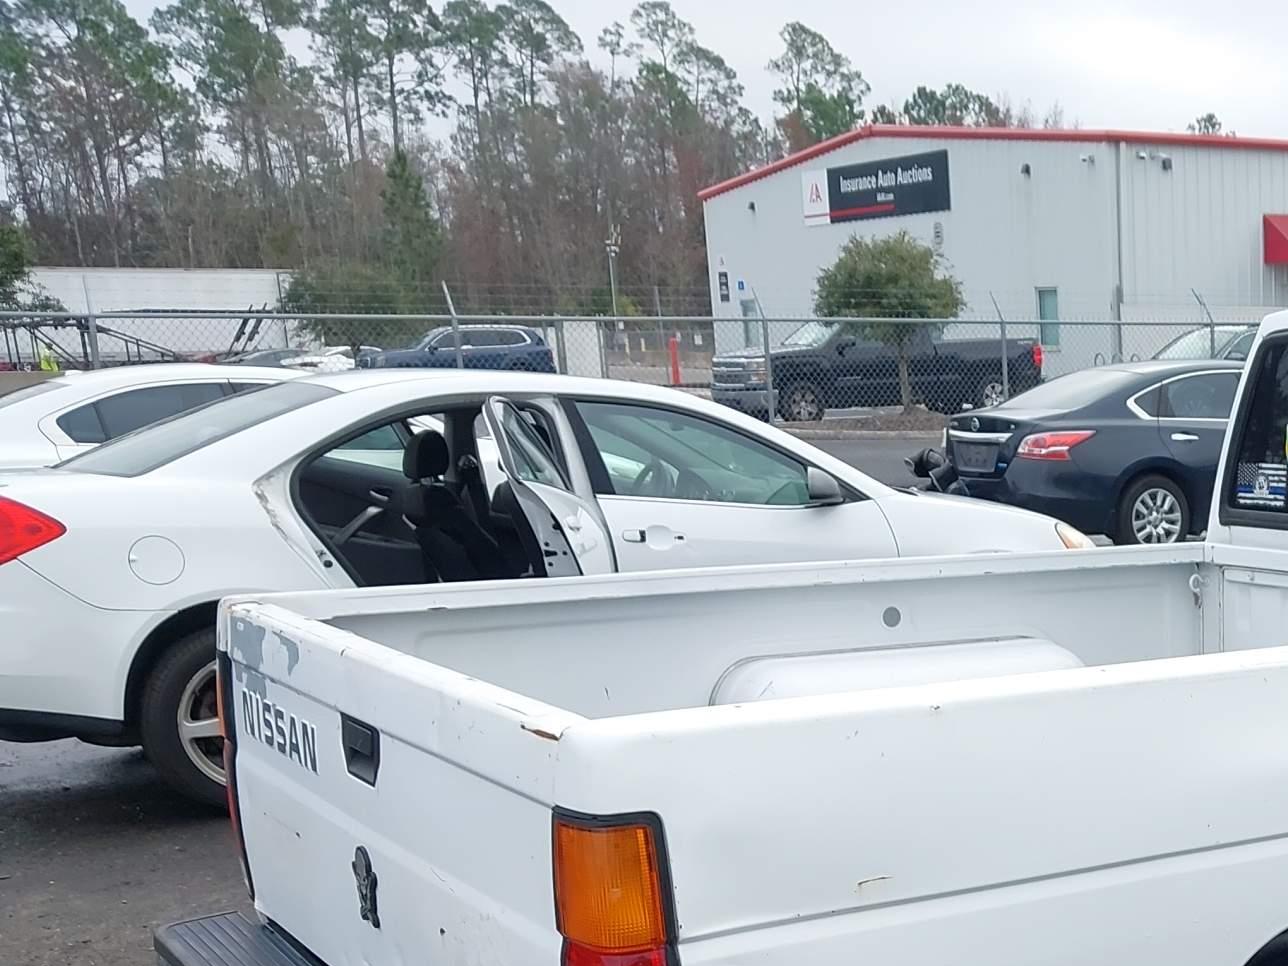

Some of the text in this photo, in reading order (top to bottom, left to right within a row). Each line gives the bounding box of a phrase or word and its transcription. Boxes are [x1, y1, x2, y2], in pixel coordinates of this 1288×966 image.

[840, 163, 933, 193] Insurance Auto Auctions
[242, 688, 319, 775] NISSAN
